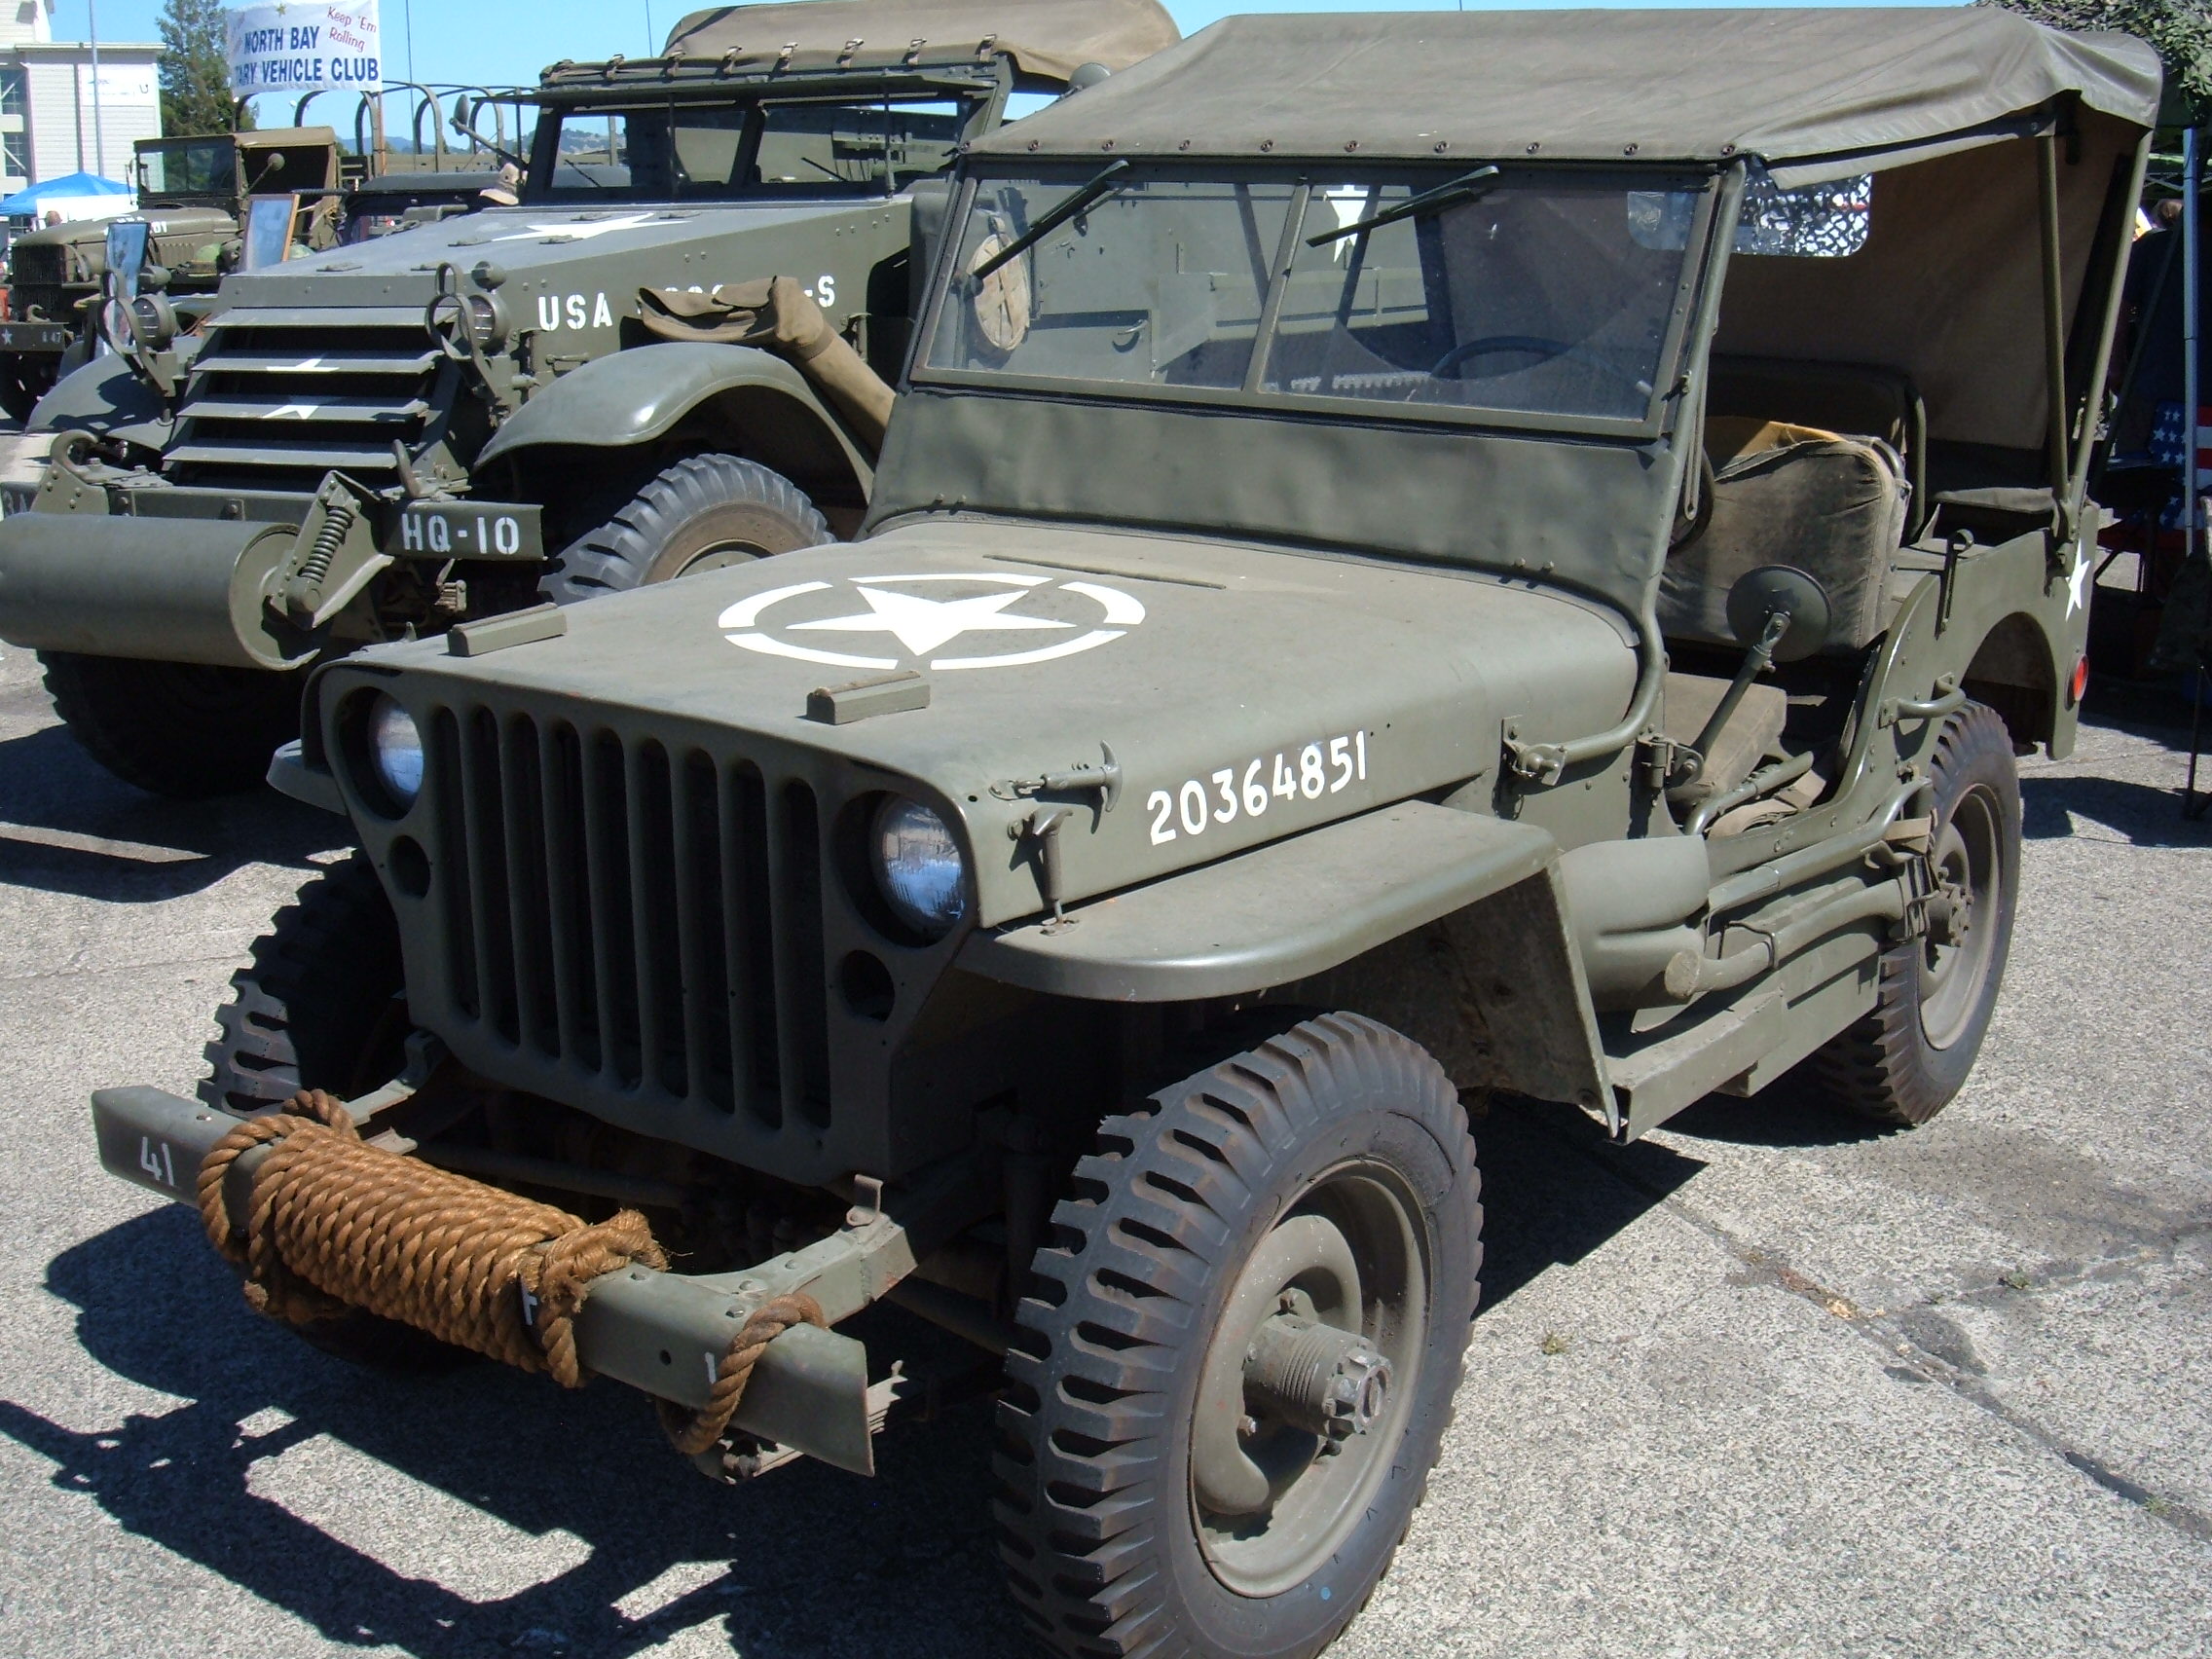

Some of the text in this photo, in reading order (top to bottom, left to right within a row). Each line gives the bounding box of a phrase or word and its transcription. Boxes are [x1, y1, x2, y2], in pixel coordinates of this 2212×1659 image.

[327, 6, 351, 26] Keep
[243, 28, 284, 55] NORTH
[290, 25, 320, 50] BAY
[328, 26, 365, 53] Rolling
[262, 58, 322, 83] VEHICLE
[331, 57, 379, 82] CLUB
[537, 292, 613, 331] USA
[1147, 730, 1366, 846] 20364851
[140, 1136, 174, 1186] 41
